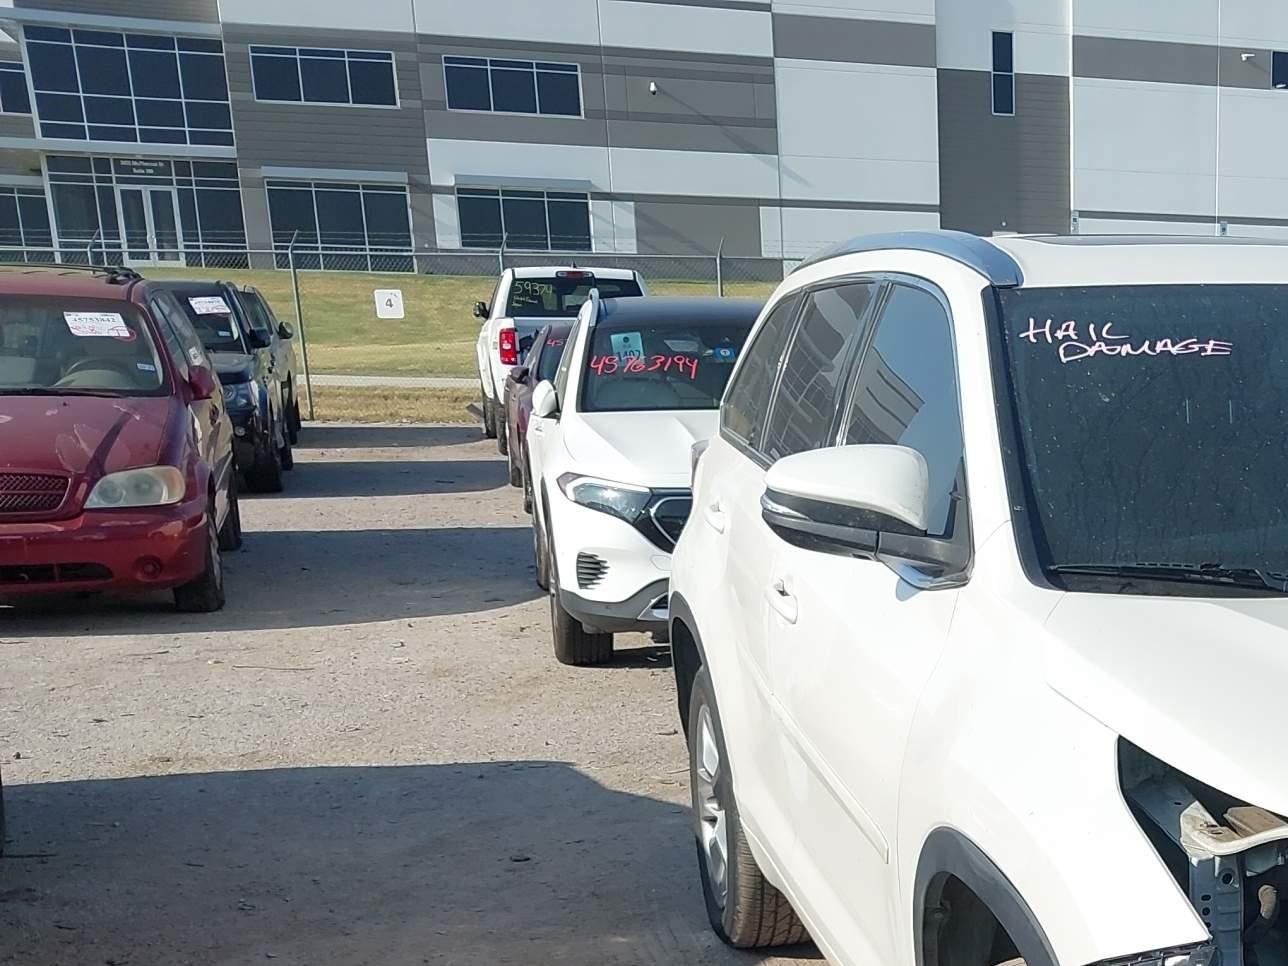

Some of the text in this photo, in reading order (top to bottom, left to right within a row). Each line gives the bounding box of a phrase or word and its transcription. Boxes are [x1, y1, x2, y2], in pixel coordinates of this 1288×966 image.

[385, 298, 394, 308] 4
[1019, 317, 1130, 343] HAIL
[591, 354, 698, 380] 45763194
